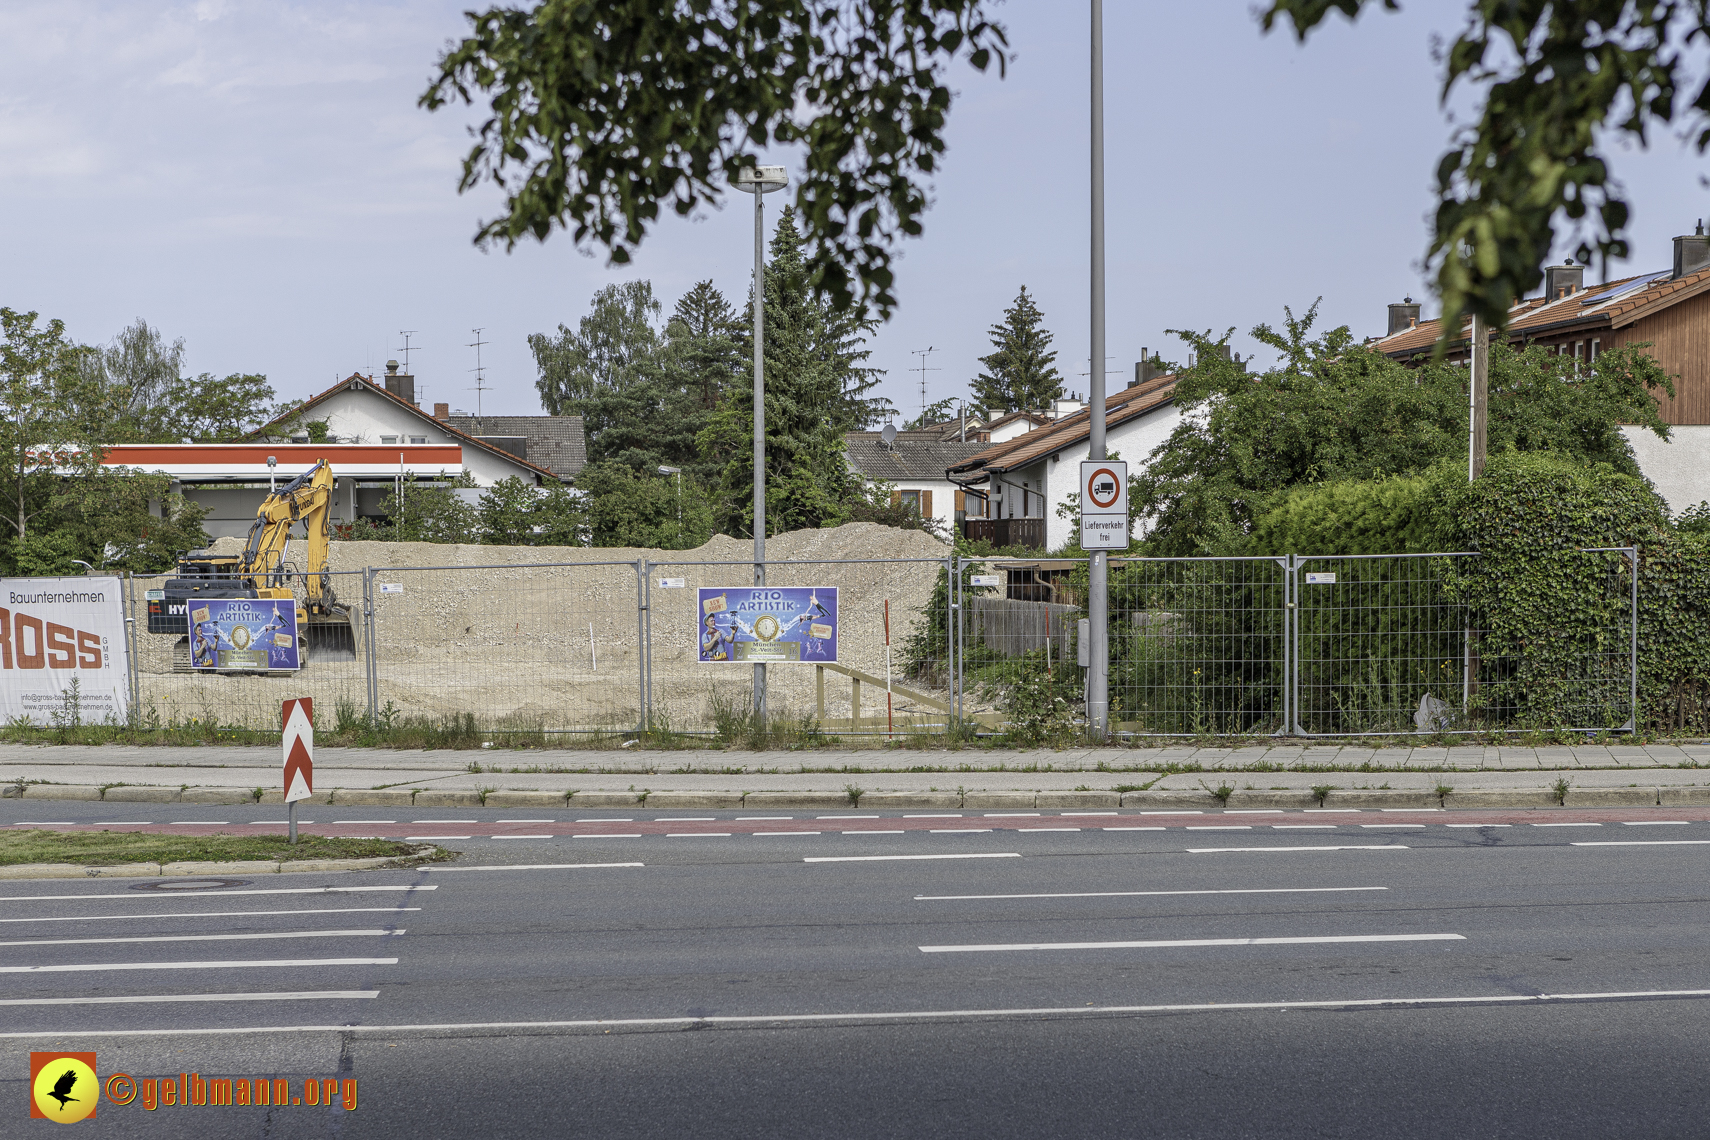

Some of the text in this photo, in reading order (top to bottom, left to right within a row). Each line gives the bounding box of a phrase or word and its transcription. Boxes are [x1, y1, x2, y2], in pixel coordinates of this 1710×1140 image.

[1084, 521, 1124, 530] Lieferverkehr
[1099, 533, 1111, 541] frei
[9, 591, 105, 604] Bauunternehmen
[752, 591, 782, 601] RIO
[168, 604, 189, 615] HY
[228, 603, 251, 612] RIO
[739, 601, 795, 611] ARTISTIK
[218, 613, 262, 622] ARTISTIK
